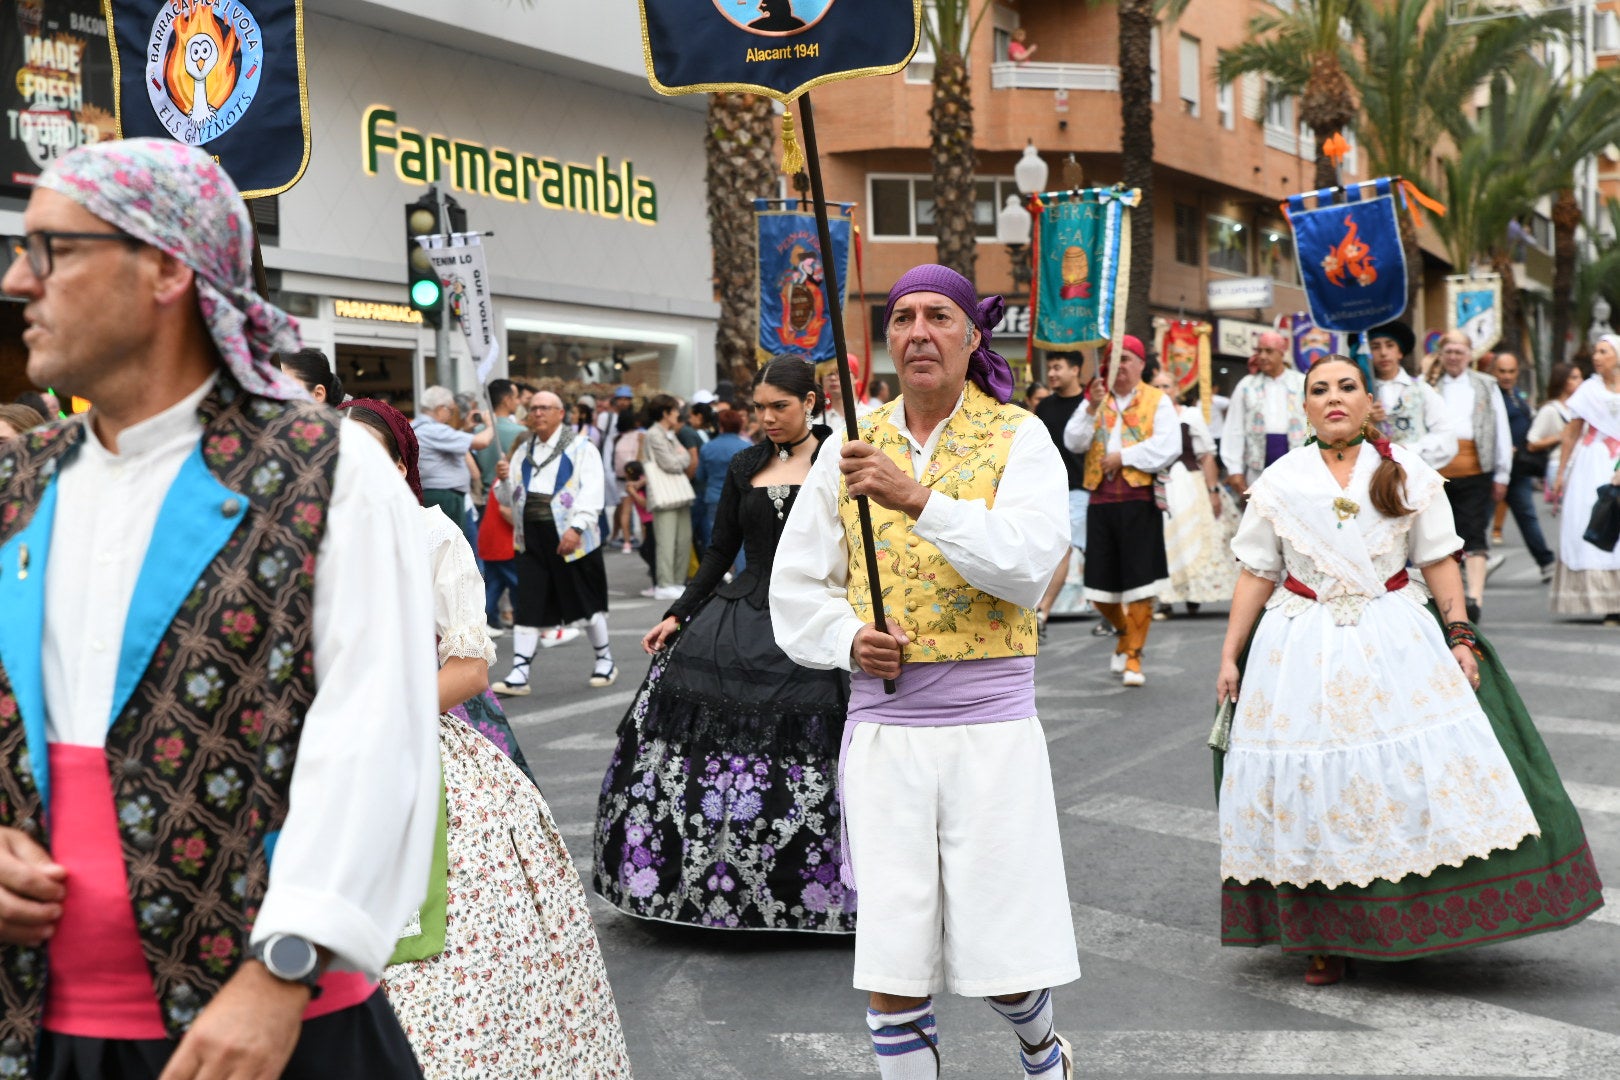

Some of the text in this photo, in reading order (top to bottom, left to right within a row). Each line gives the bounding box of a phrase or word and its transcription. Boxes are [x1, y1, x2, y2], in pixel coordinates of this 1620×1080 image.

[151, 0, 190, 62] BARRACA
[224, 1, 230, 11] I
[233, 8, 258, 50] VOLA
[24, 34, 80, 74] MADE
[745, 42, 819, 63] Alacant 1941
[24, 73, 82, 112] FRESH
[7, 109, 32, 143] TO
[159, 91, 252, 144] ELS GAVINOTS
[363, 106, 658, 226] Farmarambla
[431, 254, 473, 267] TENIM LO
[473, 269, 491, 345] QUE VOLEM
